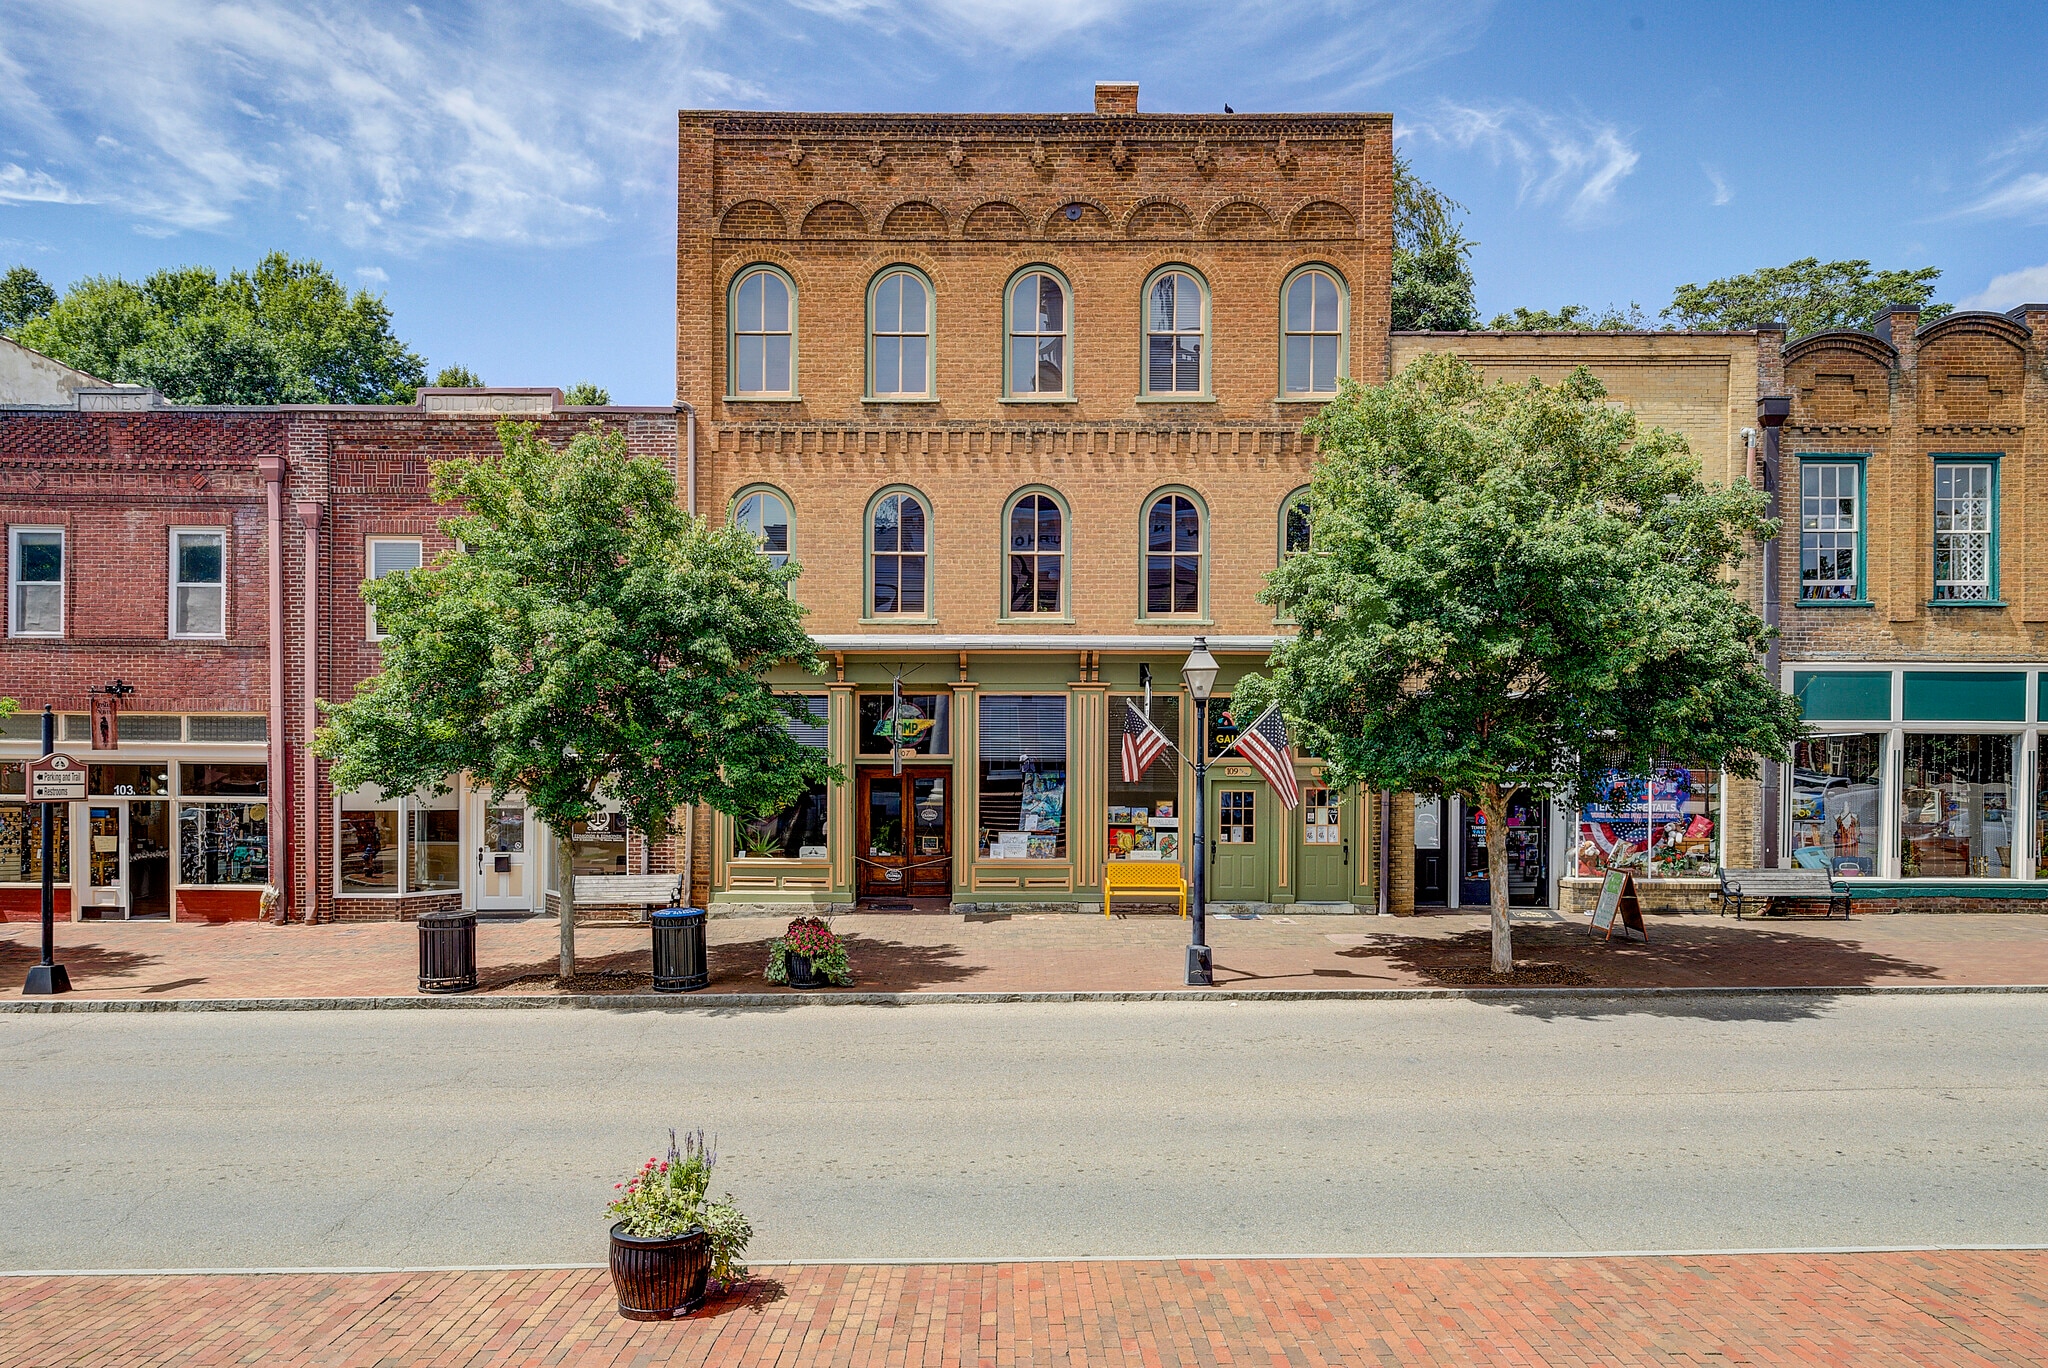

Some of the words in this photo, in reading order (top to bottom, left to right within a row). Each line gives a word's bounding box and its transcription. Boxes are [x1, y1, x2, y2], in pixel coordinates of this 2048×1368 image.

[1226, 767, 1239, 775] 109
[44, 772, 62, 783] Parking
[62, 772, 71, 781] and
[71, 772, 81, 781] Trail
[44, 787, 68, 796] Restrooms
[114, 785, 134, 795] 103
[1652, 803, 1676, 812] TAILS
